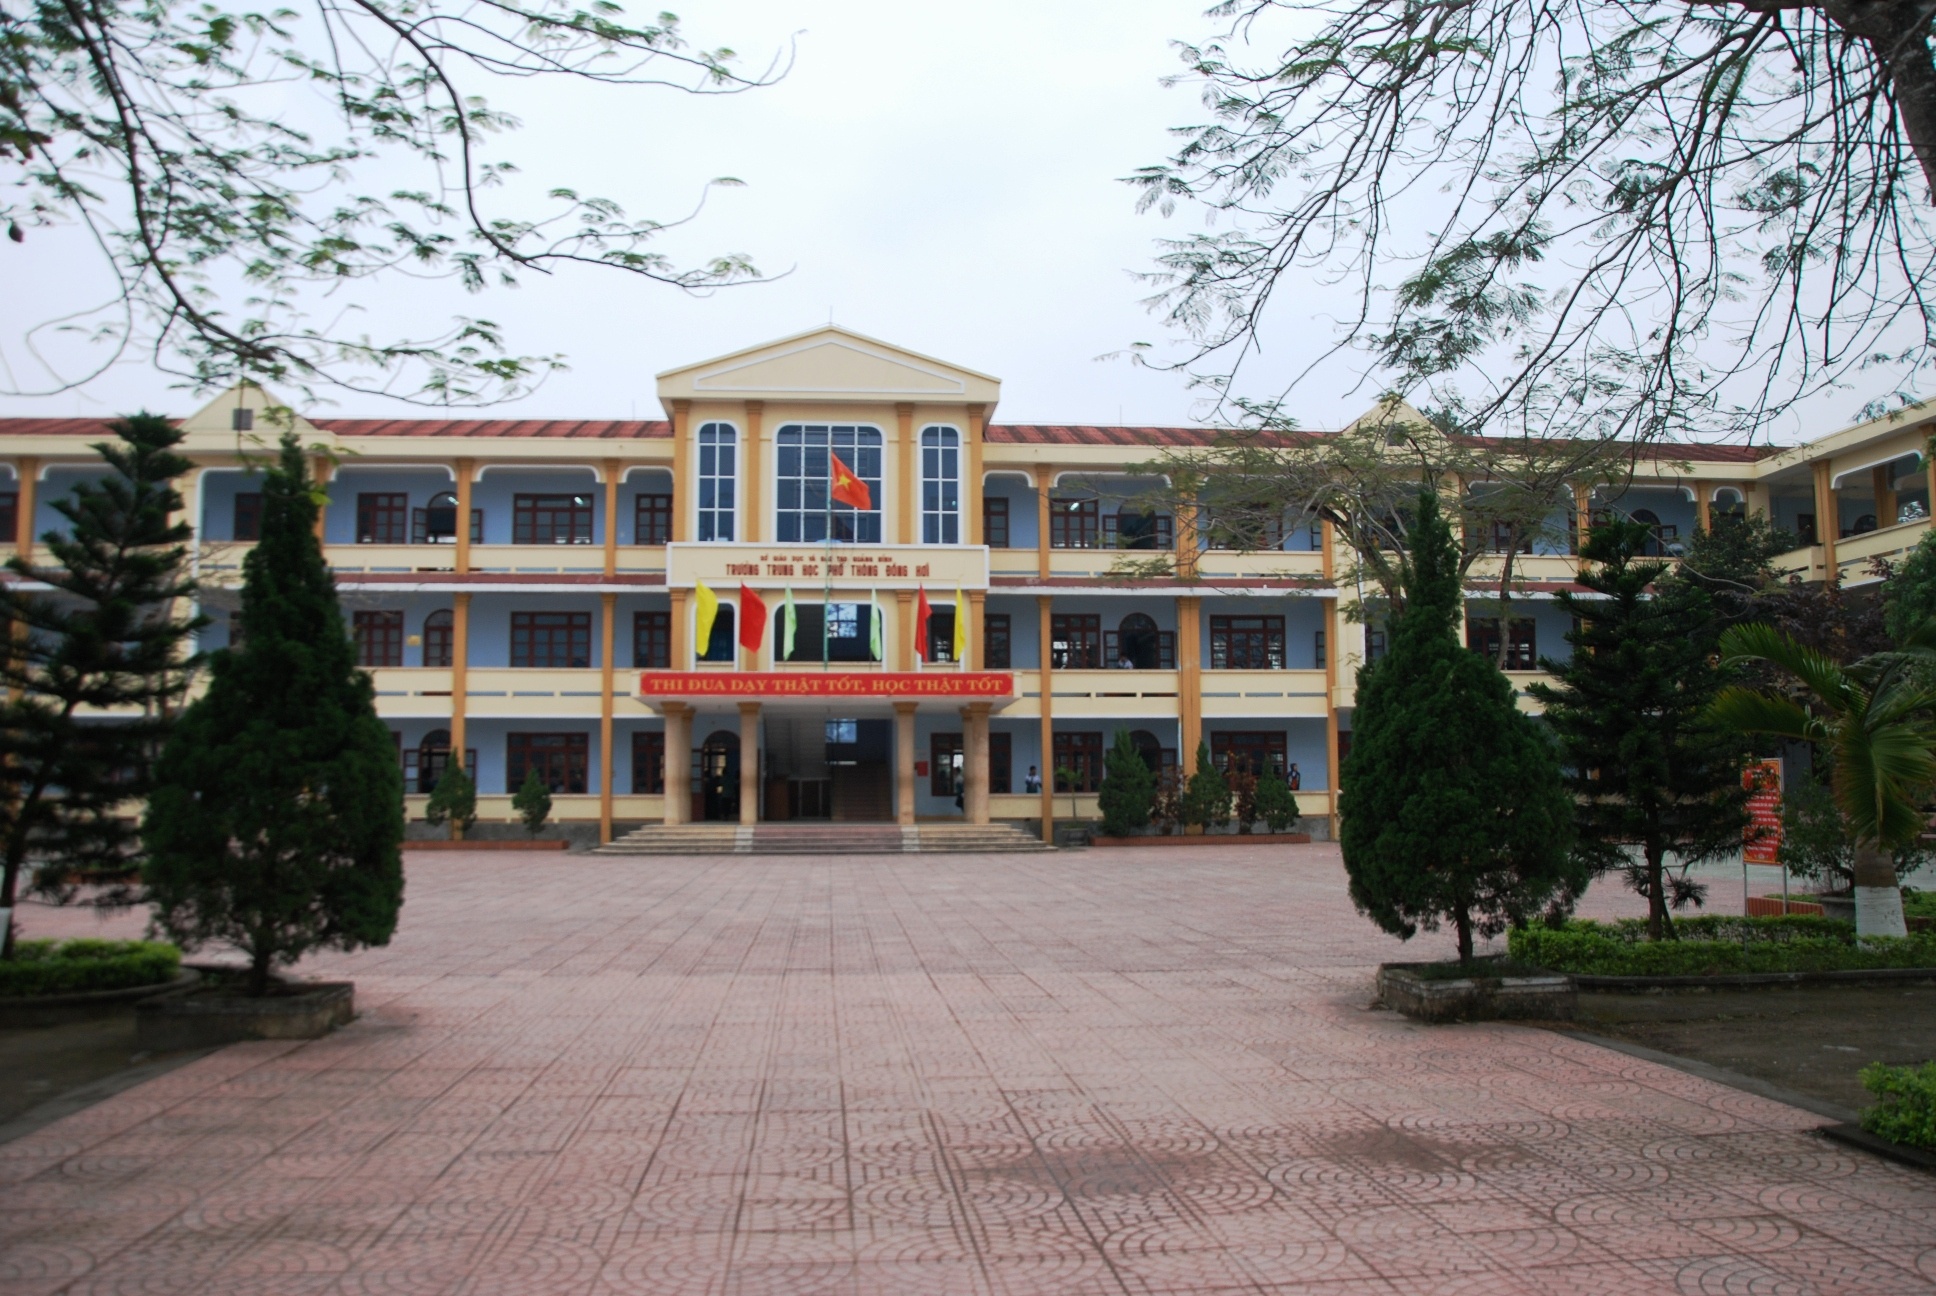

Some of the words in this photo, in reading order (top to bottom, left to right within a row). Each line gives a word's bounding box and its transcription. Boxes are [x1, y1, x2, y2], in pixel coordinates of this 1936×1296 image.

[726, 560, 759, 576] TRƯỜNG
[766, 563, 794, 576] TRUNG
[802, 564, 819, 577] HỌC
[650, 679, 684, 691] THI
[688, 679, 727, 691] ĐUA
[730, 679, 768, 693] DẠY
[772, 677, 822, 693] THẬT
[826, 676, 867, 692] TỐT,
[872, 679, 911, 693] HỌC
[914, 677, 964, 693] THẬT
[966, 677, 1004, 692] TỐT
